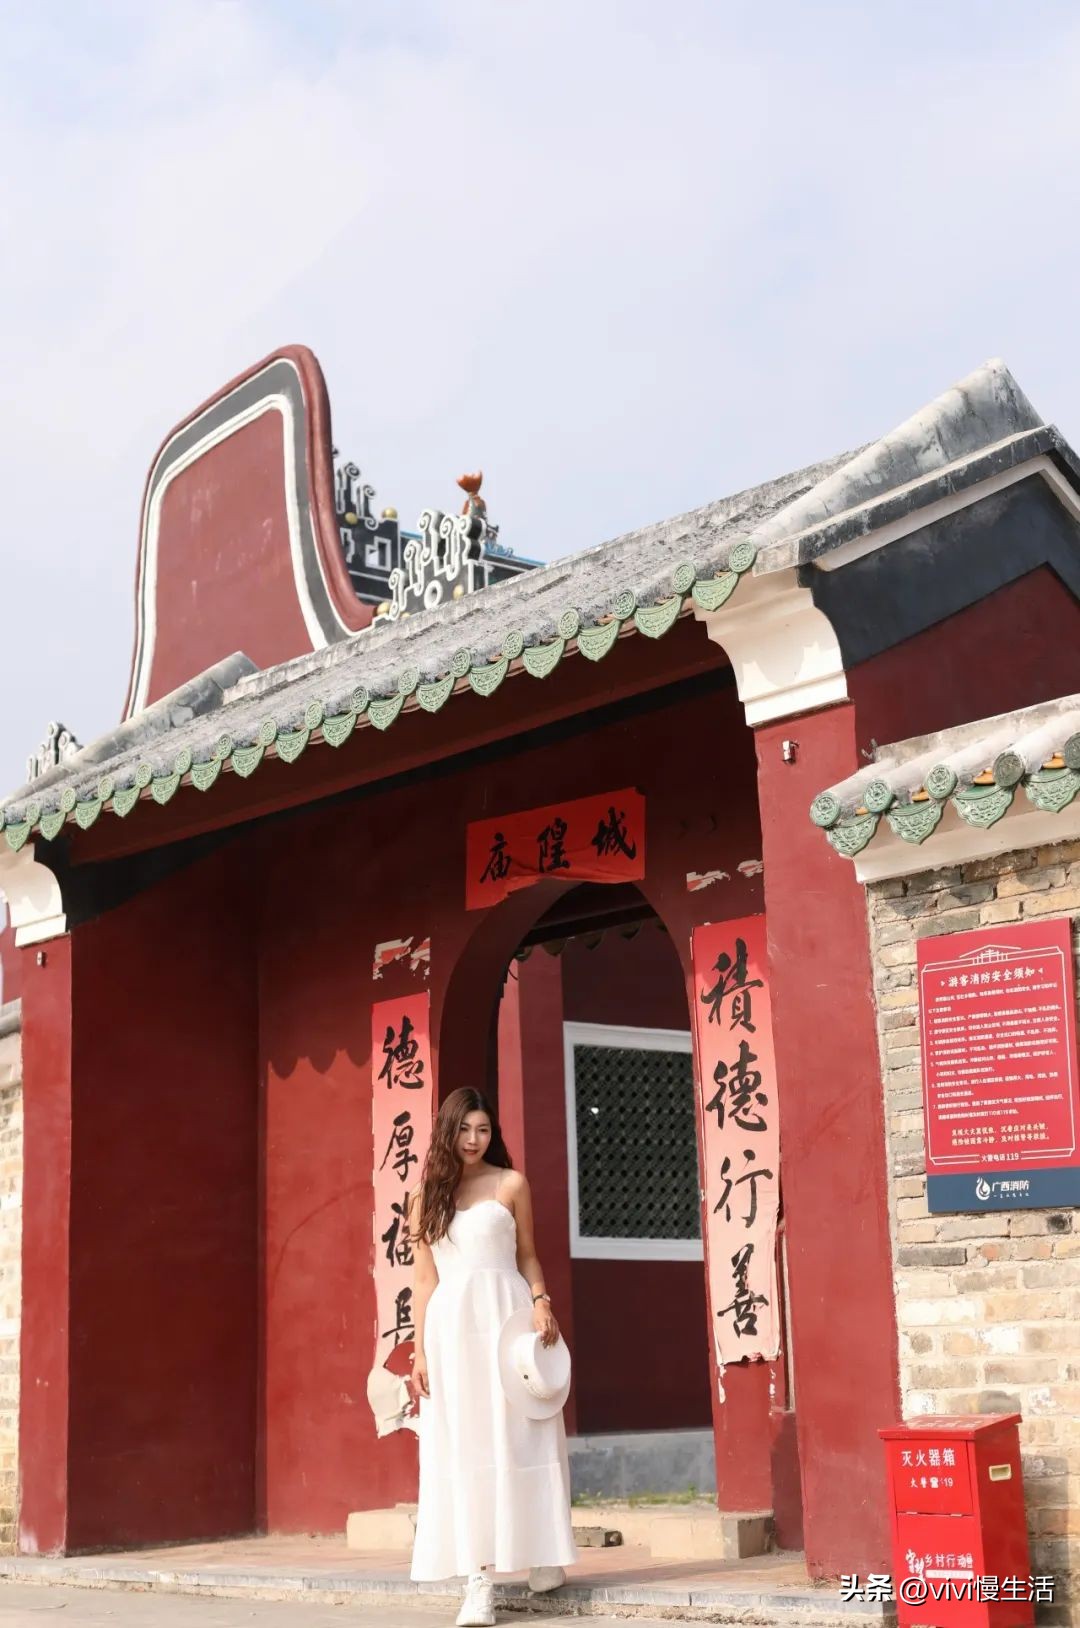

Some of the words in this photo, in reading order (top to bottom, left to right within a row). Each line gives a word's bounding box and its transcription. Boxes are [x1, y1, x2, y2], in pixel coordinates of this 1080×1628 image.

[479, 806, 636, 884] 城隍庙
[948, 966, 1036, 988] 游客消防安全须知
[701, 937, 773, 1339] 積德行善
[992, 1179, 1030, 1192] 广西消防
[901, 1447, 955, 1467] 灭火器箱
